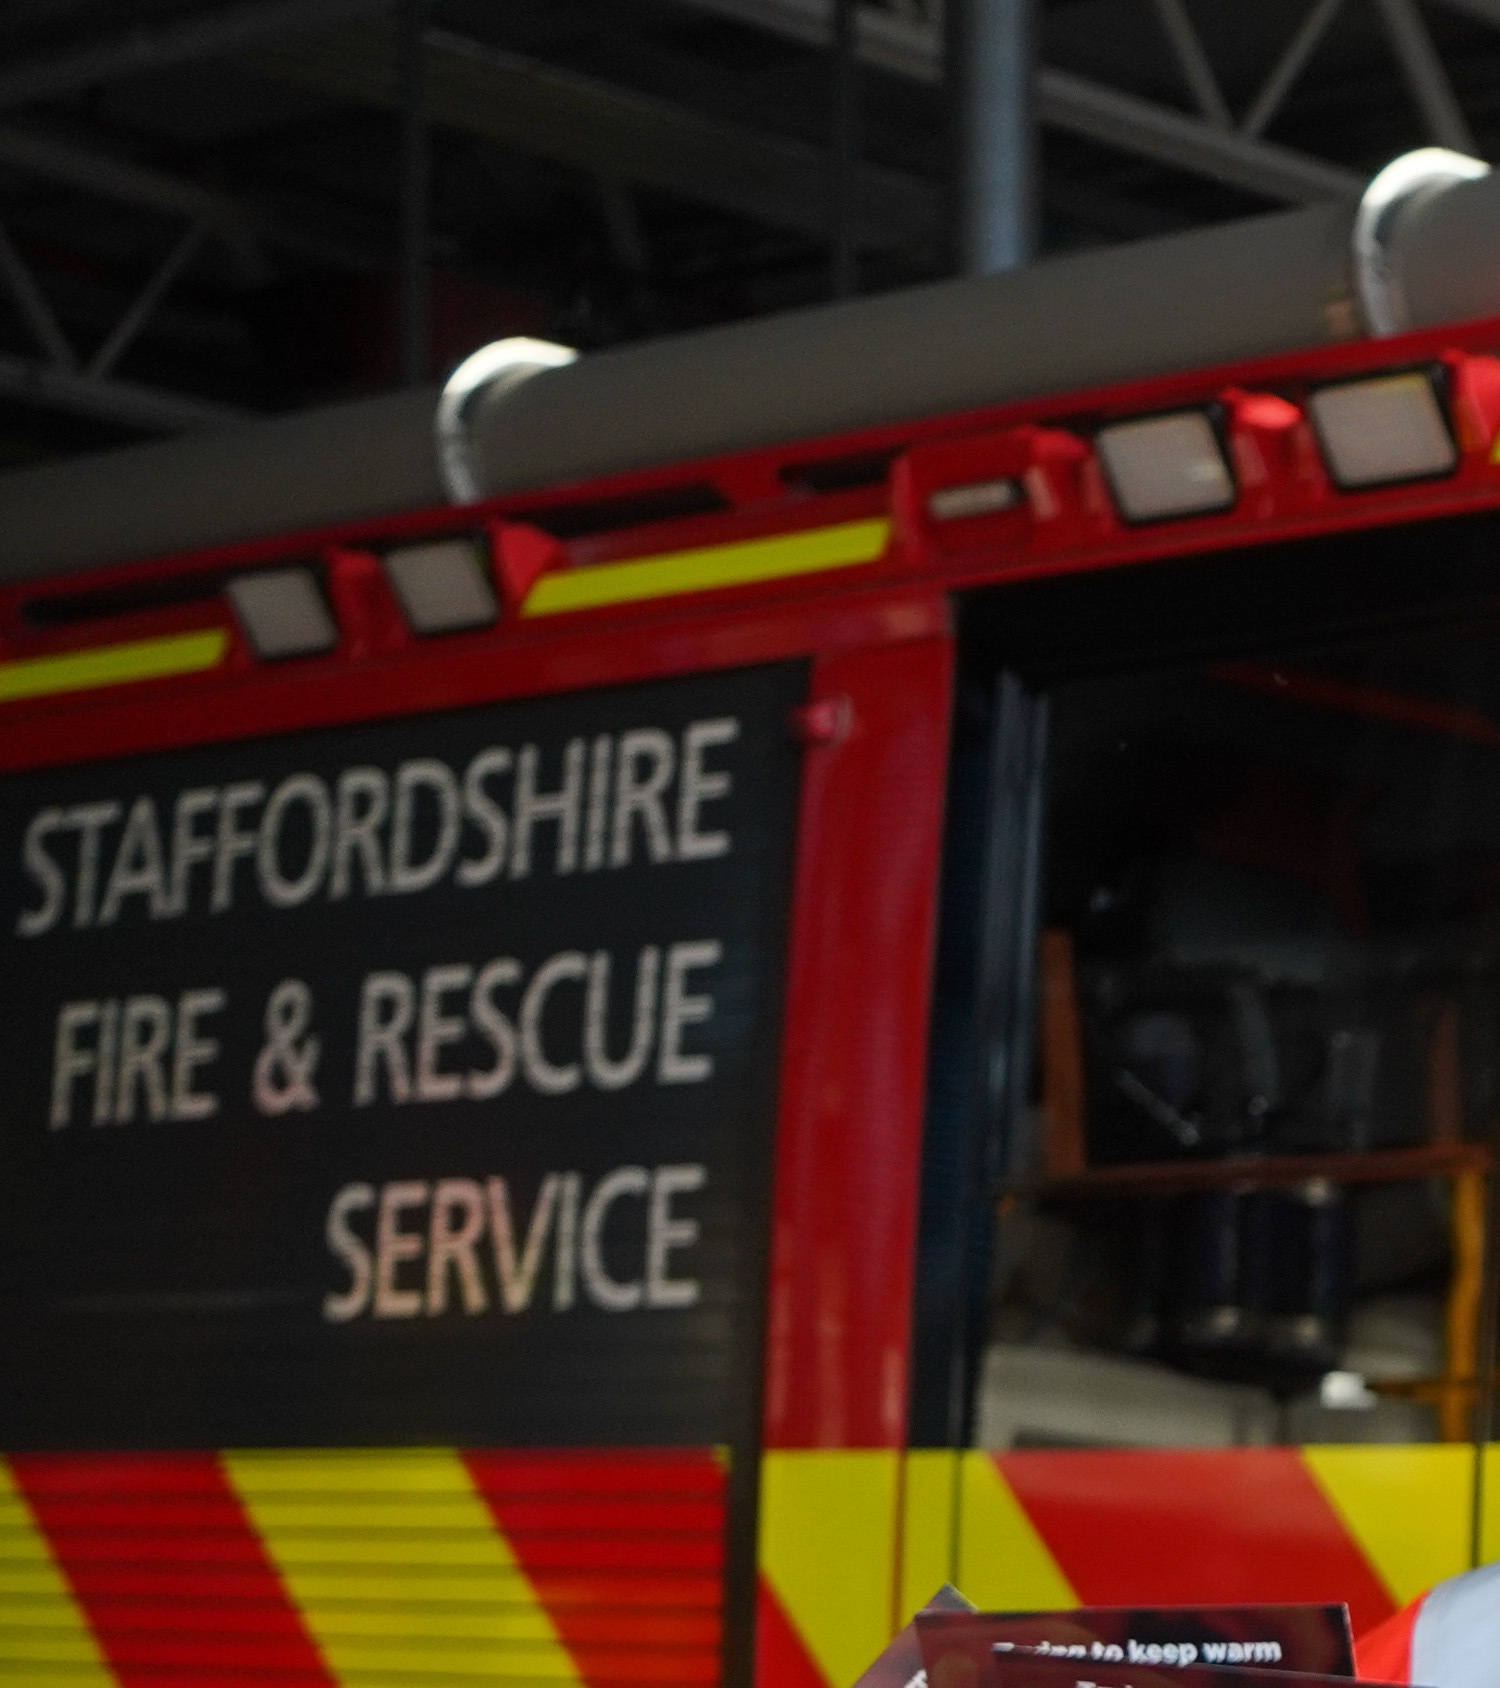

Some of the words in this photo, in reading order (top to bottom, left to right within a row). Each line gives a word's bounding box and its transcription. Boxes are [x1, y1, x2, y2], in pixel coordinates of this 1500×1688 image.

[17, 715, 740, 938] STAFFORDSHIRE
[50, 987, 227, 1130] FIRE
[252, 977, 322, 1115] &
[353, 939, 722, 1108] RESCUE
[323, 1163, 707, 1322] SERVICE
[1202, 1641, 1283, 1663] warm
